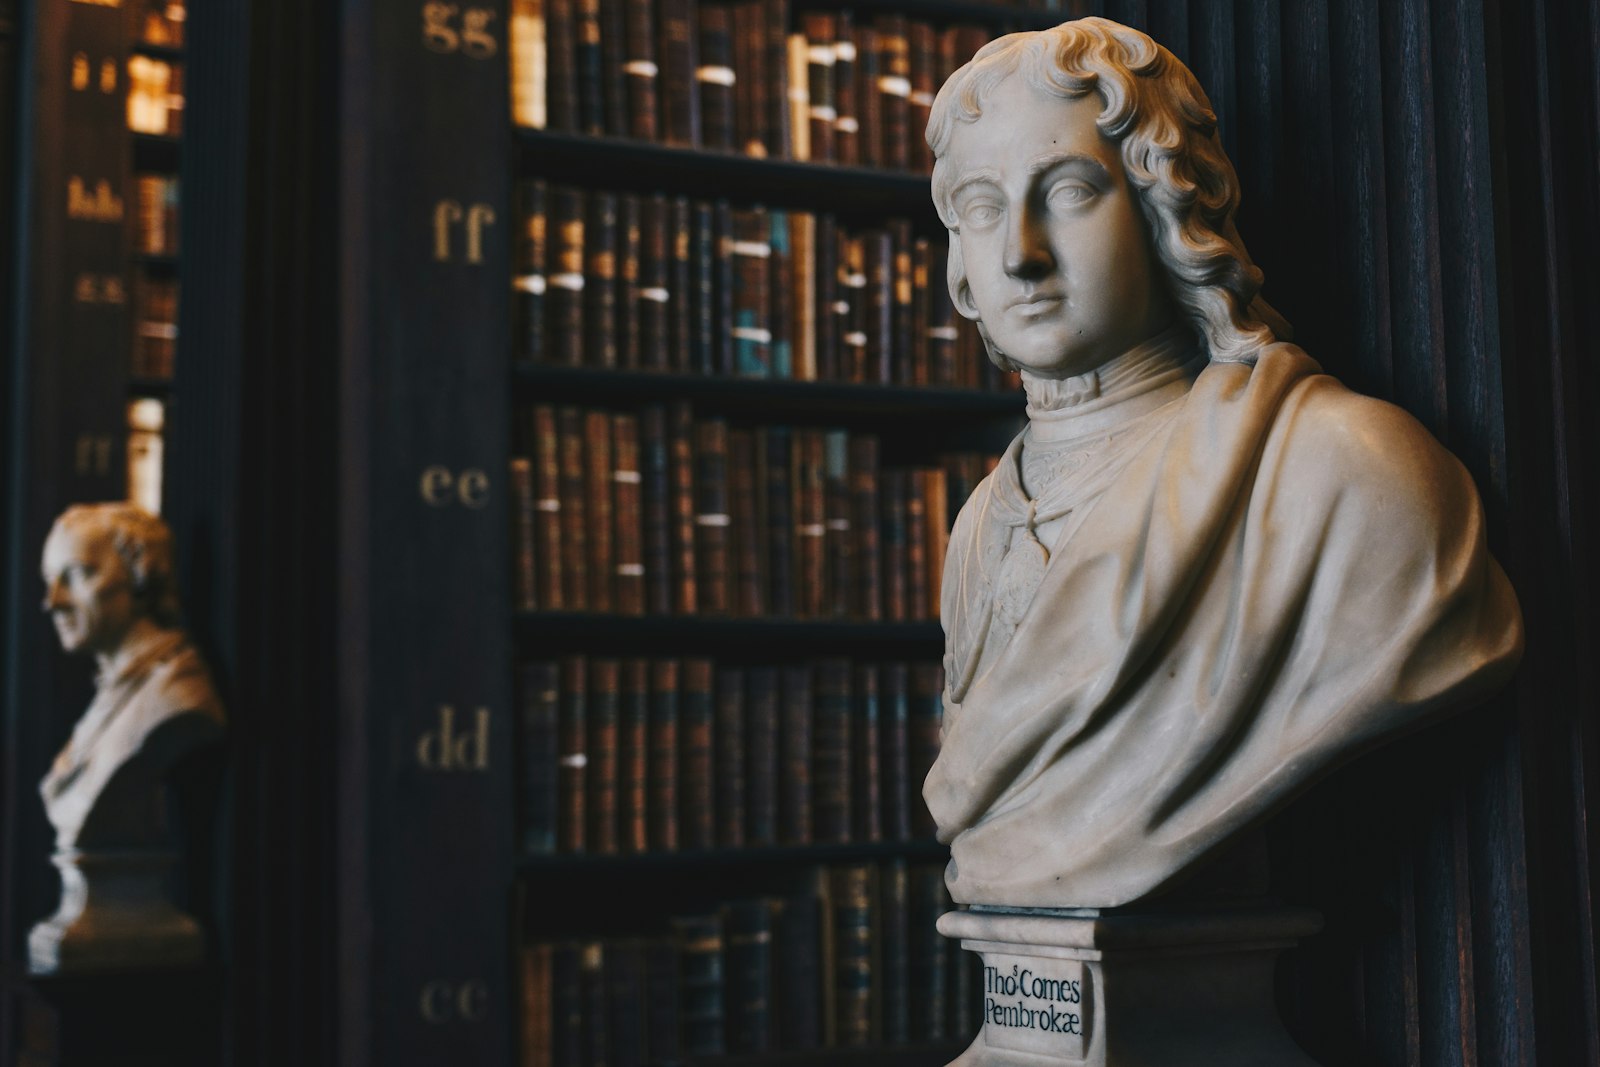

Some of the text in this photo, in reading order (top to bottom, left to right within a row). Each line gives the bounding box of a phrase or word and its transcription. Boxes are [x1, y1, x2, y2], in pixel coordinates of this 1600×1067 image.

[422, 0, 497, 54] gg
[432, 199, 496, 265] ff
[419, 466, 491, 505] ee
[417, 704, 491, 772] dd
[1019, 969, 1080, 1004] Comes
